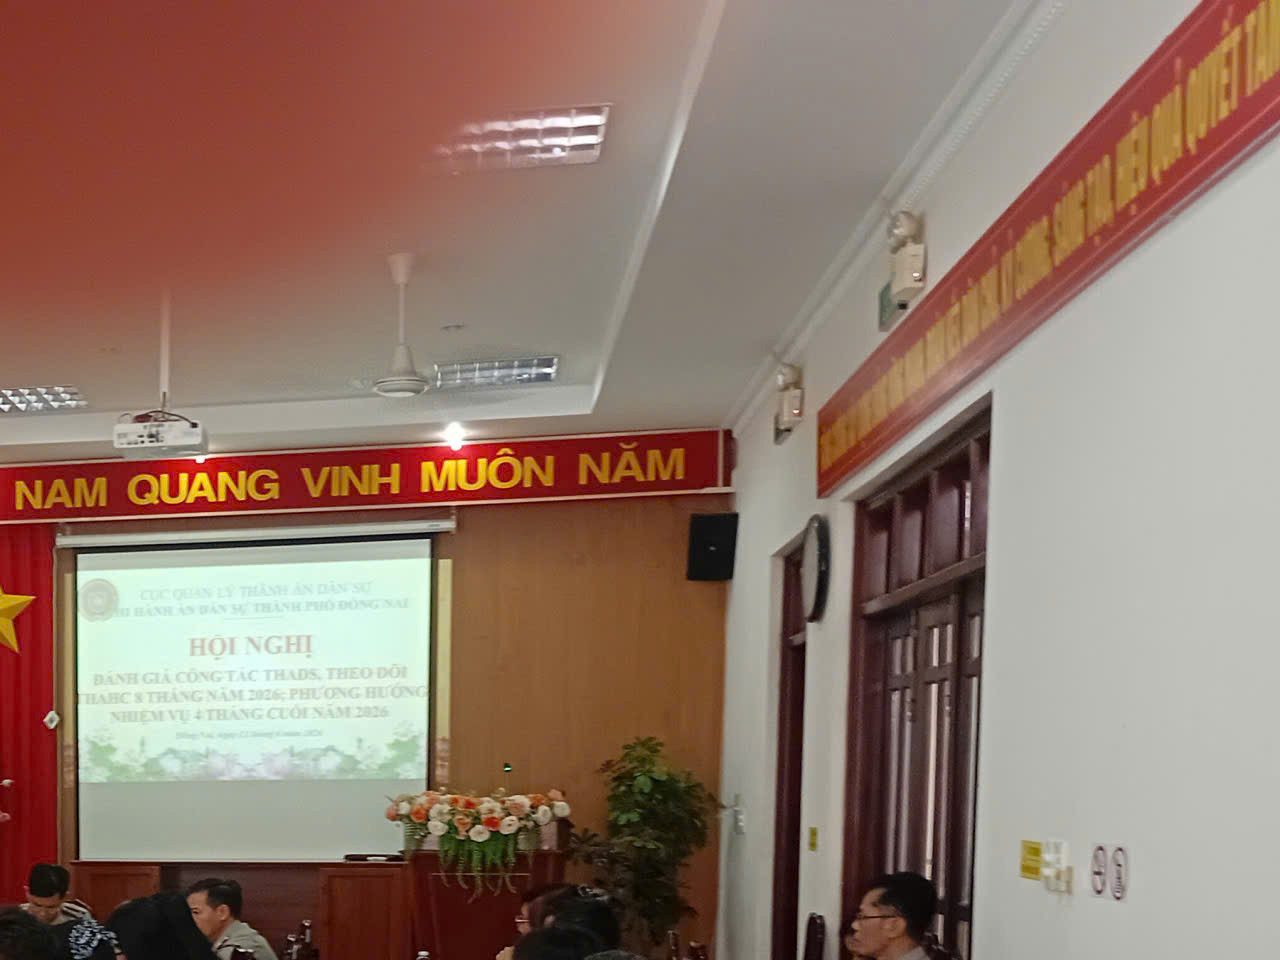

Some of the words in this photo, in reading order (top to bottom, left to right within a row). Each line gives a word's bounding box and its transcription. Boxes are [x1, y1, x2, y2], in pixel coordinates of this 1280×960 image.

[15, 476, 108, 510] NAM
[128, 468, 280, 505] QUANG
[301, 463, 401, 498] VINH
[420, 448, 555, 492] MUÔN
[578, 441, 686, 484] NĂM
[188, 633, 237, 661] HỘI
[245, 633, 313, 660] NGHỊ
[93, 670, 139, 686] ĐÁNH
[175, 667, 221, 684] CÔNG
[223, 668, 258, 683] TÁC
[326, 666, 373, 681] THEO
[146, 688, 203, 704] THÁNG
[205, 686, 246, 702] NĂM
[289, 685, 361, 701] PHƯƠNG
[205, 705, 264, 722] THÁNG
[311, 703, 351, 719] NĂM
